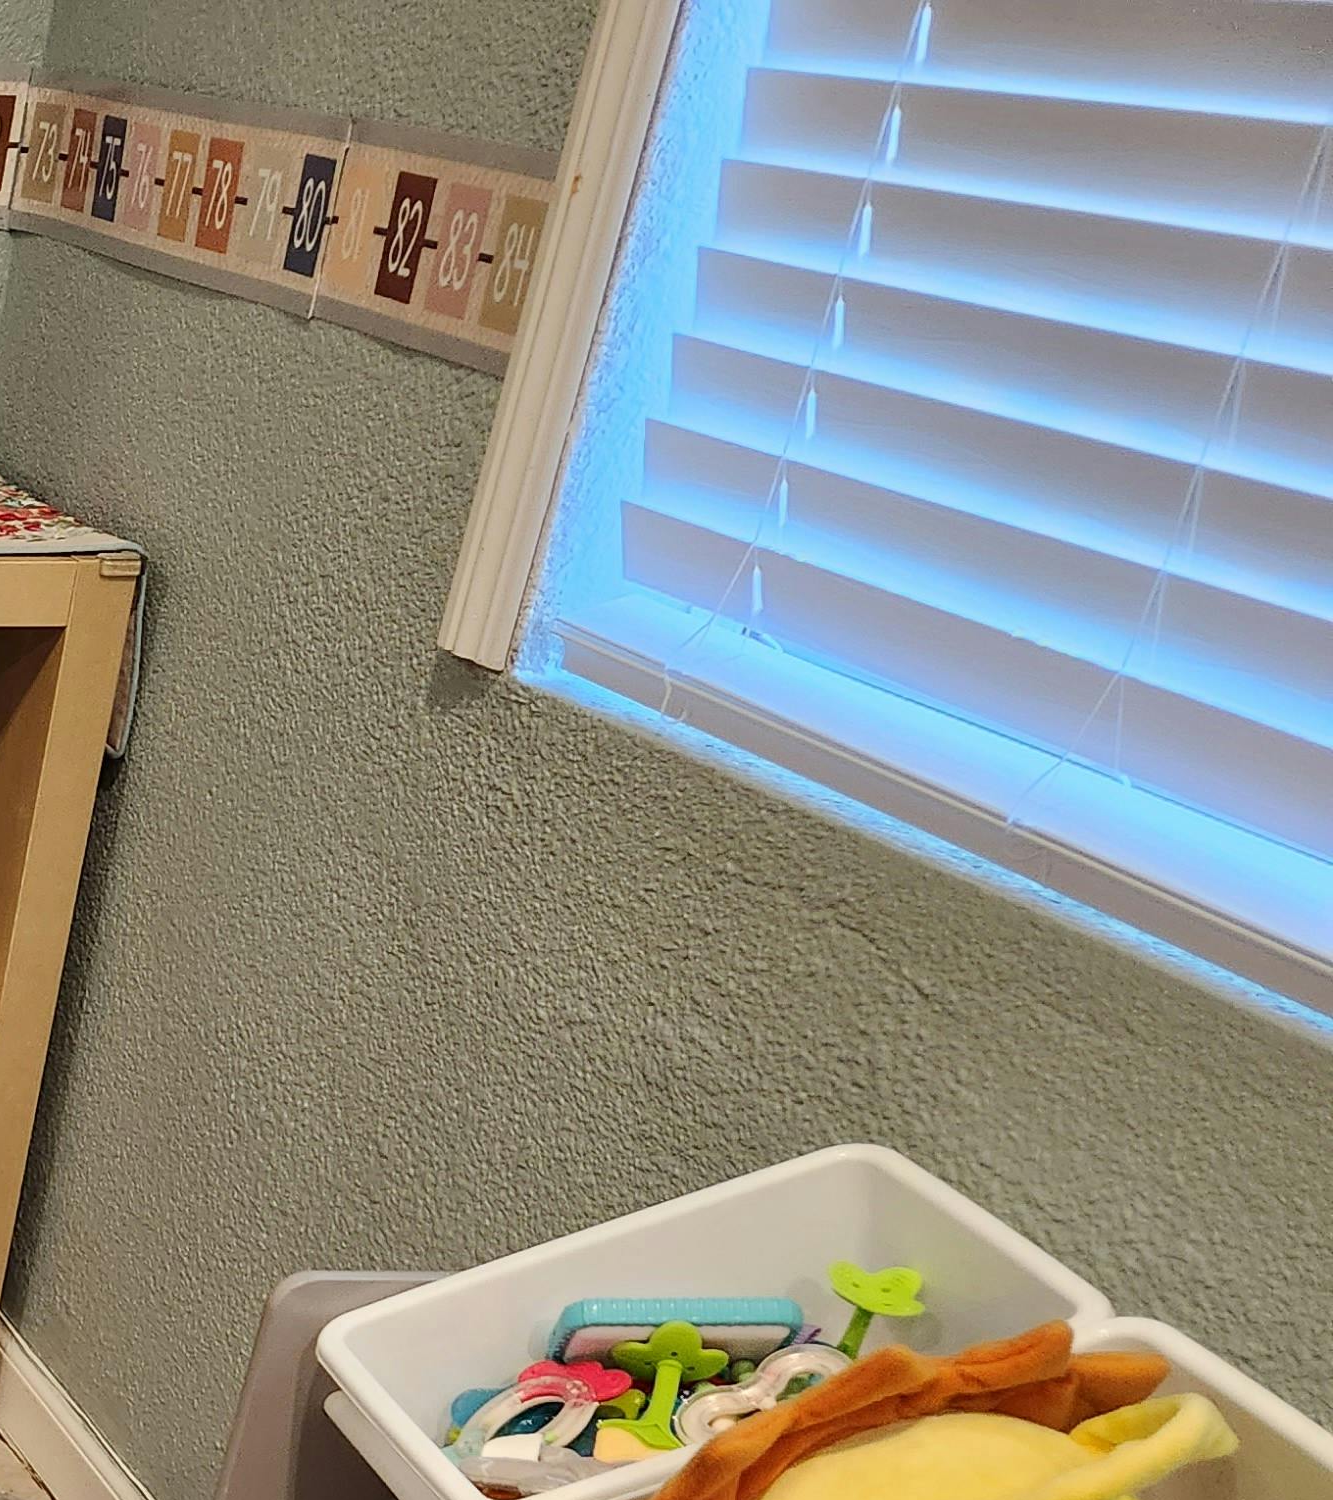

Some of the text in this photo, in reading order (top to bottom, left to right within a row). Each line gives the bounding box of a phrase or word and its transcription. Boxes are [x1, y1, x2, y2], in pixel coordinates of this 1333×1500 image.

[32, 121, 535, 307] 73 74 75 76 77 78 79 80 81 82 83 84
